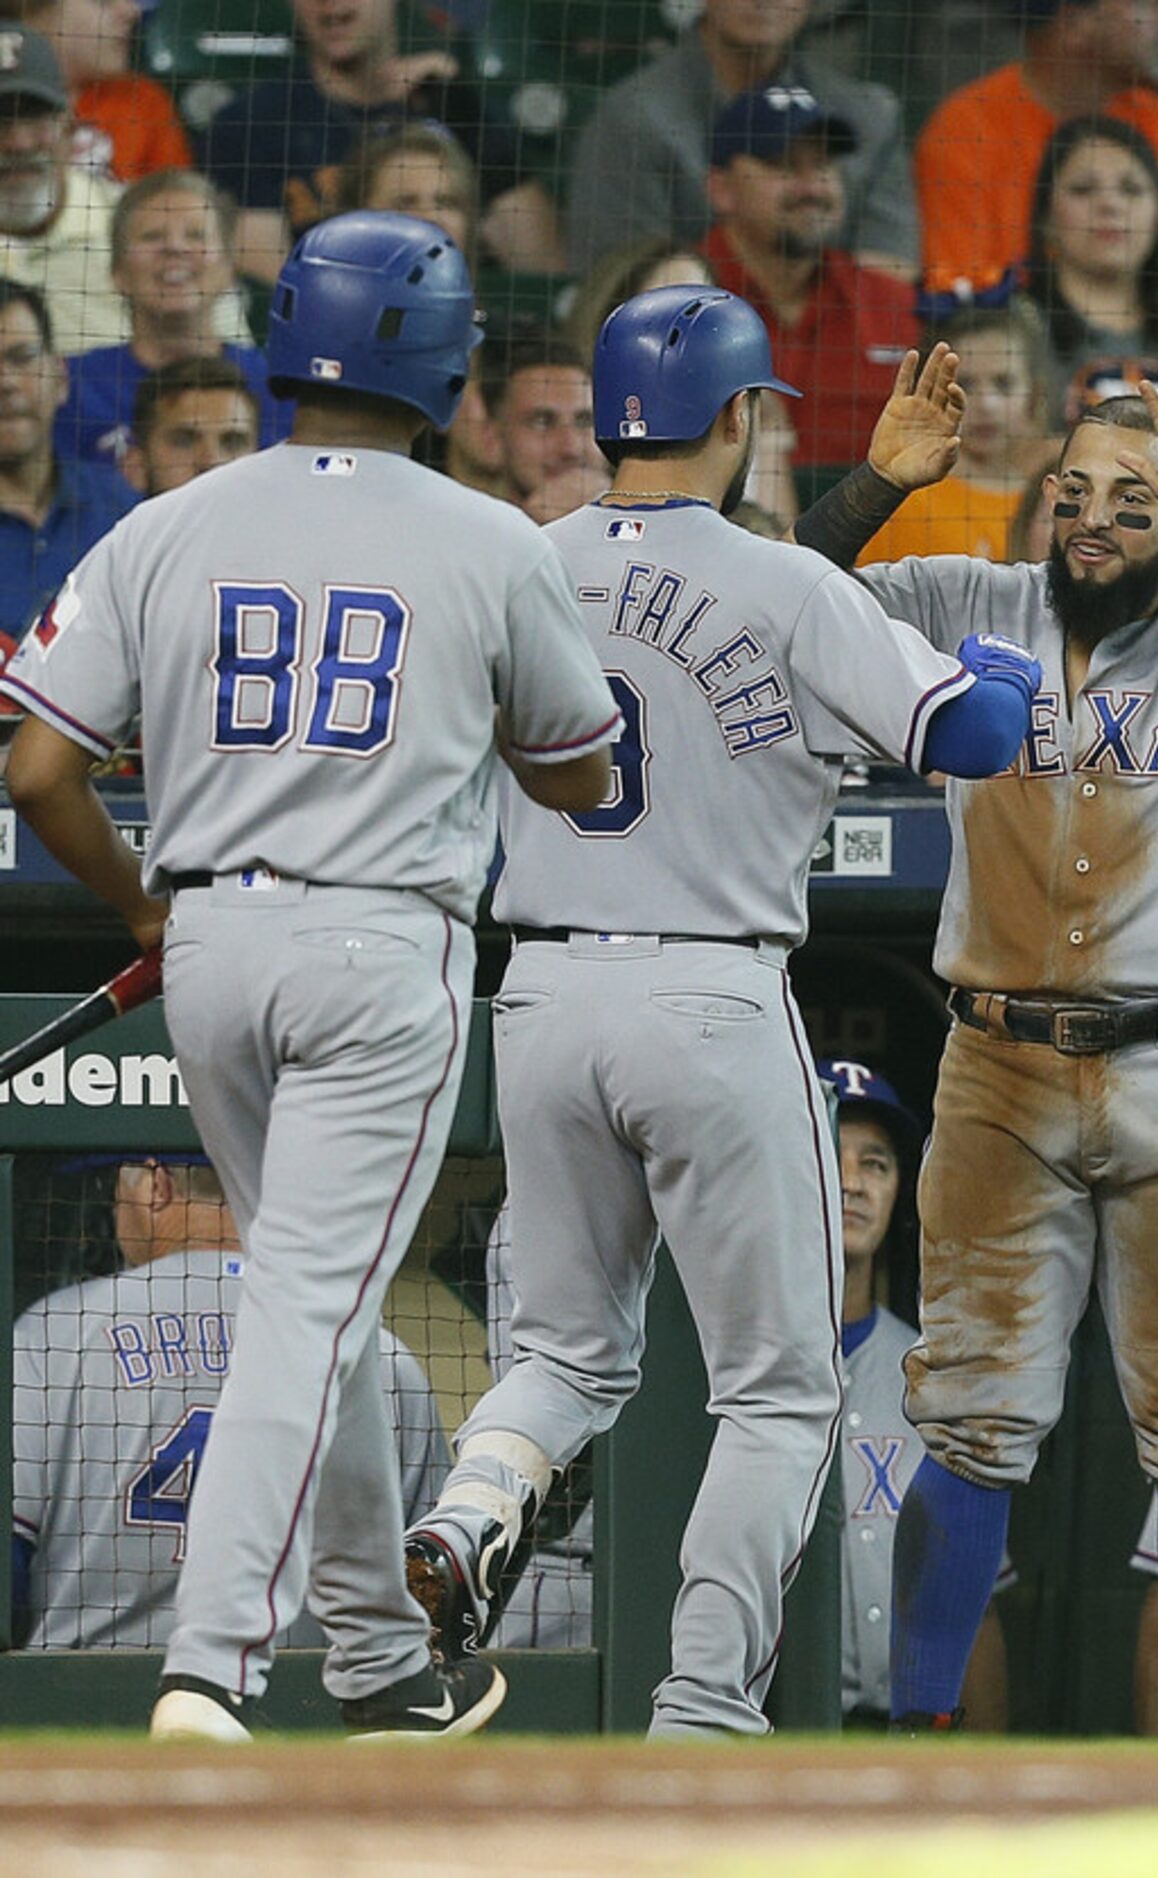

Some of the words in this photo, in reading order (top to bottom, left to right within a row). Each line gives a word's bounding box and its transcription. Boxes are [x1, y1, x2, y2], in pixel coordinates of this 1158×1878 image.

[843, 846, 884, 863] ERA
[0, 1046, 191, 1106] dem
[831, 1061, 875, 1096] T
[847, 1436, 906, 1520] X
